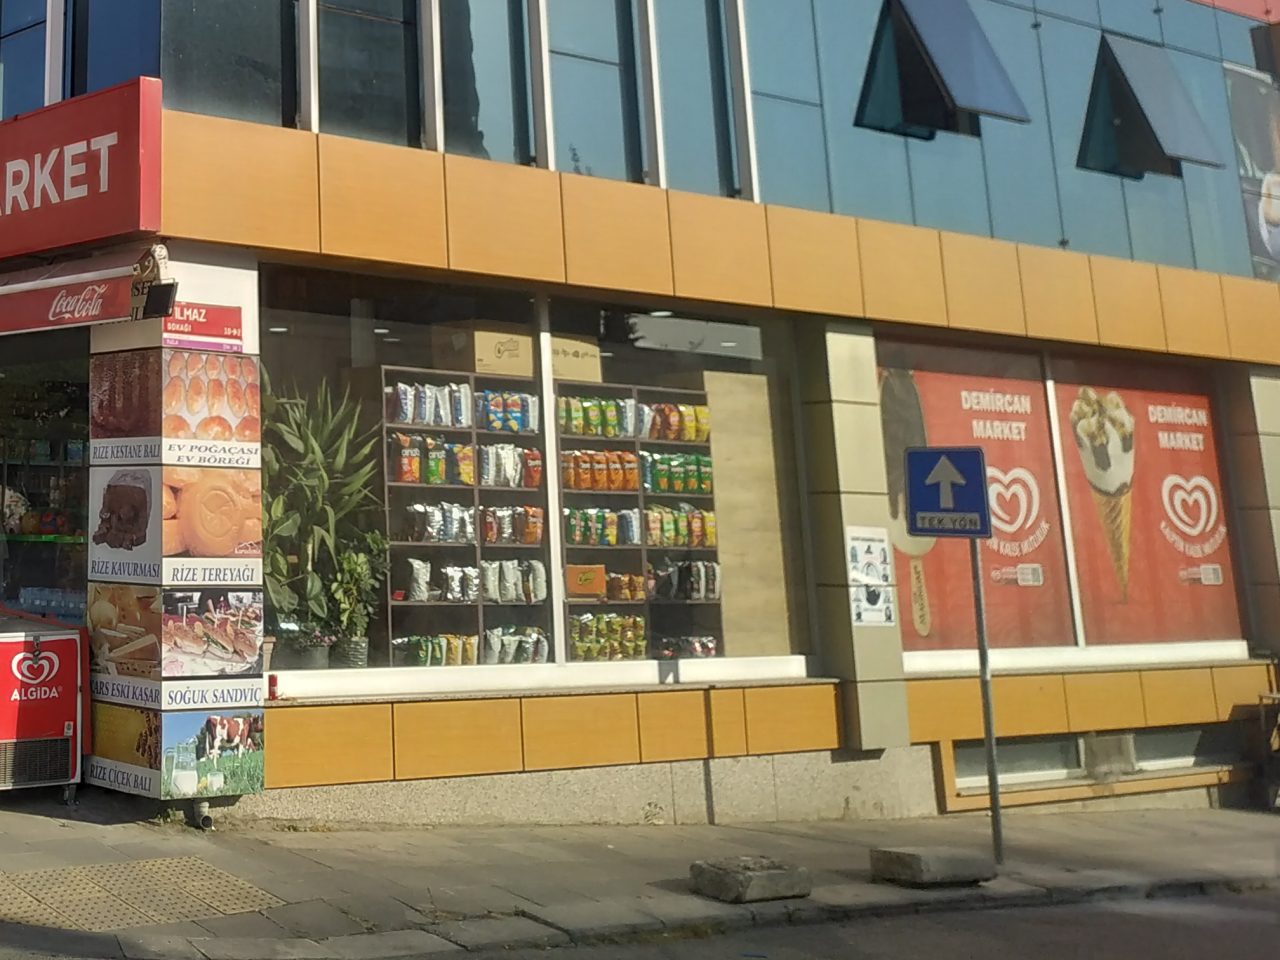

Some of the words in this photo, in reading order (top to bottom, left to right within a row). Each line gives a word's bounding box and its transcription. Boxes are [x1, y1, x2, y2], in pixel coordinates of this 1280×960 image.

[48, 283, 108, 321] Coca-Cola
[172, 306, 207, 322] ILMAZ
[961, 388, 1032, 415] DEMİRCAN
[972, 419, 1026, 441] MARKET
[168, 444, 185, 452] EV
[189, 444, 259, 456] POĞAÇASI
[1158, 431, 1205, 452] MARKET
[110, 444, 143, 459] KESTANE
[143, 444, 160, 458] BALI
[176, 455, 194, 463] EV
[920, 516, 945, 528] TEK
[952, 516, 979, 528] YÖN
[91, 557, 110, 575] RİZE
[111, 561, 160, 578] KAVURMASI
[171, 564, 198, 582] RİZE
[200, 564, 255, 582] TEREYAĞI
[110, 681, 130, 700] ESKİ
[131, 683, 160, 705] KAŞAR
[167, 686, 209, 705] SOĞUK
[211, 683, 262, 706] SANDVİÇ
[133, 774, 152, 792] BALI
